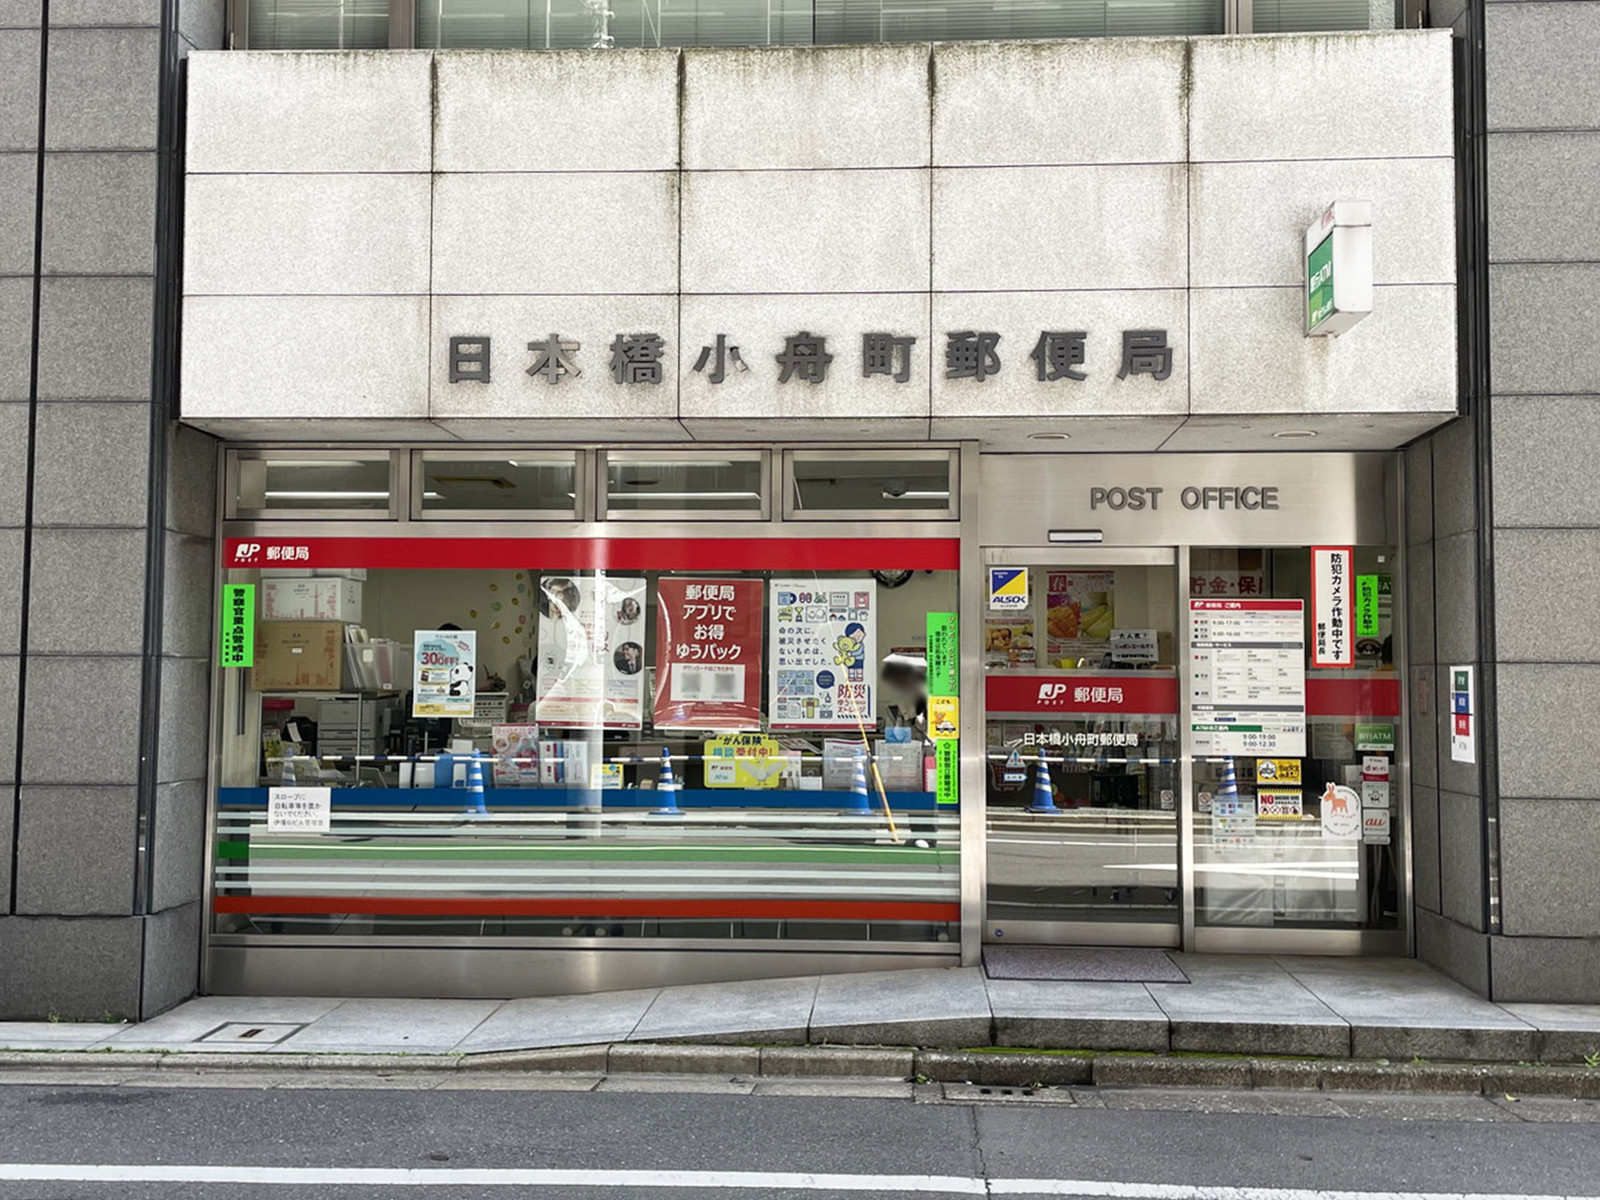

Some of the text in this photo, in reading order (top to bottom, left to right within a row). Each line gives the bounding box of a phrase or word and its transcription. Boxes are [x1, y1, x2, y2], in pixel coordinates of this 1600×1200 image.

[449, 330, 1173, 385] 日本橋小舟町郵便局
[1090, 486, 1280, 511] POST OFFICE
[266, 545, 310, 561] 郵便局
[685, 584, 736, 601] 郵便局
[992, 595, 1026, 604] ALSOK
[682, 604, 736, 621] アプリで
[1330, 552, 1344, 661] 防犯カメラ作動中です
[693, 624, 725, 641] お得
[1317, 622, 1326, 656] 郵便局長
[676, 642, 742, 660] ゆうパック
[837, 684, 866, 698] 防災
[1038, 683, 1124, 704] JP 郵便局
[1023, 732, 1139, 747] 日本橋小舟町郵便局
[274, 793, 306, 801] スロープに
[1260, 795, 1274, 805] NO
[274, 802, 322, 810] 自転車等を置か
[1365, 818, 1386, 826] au
